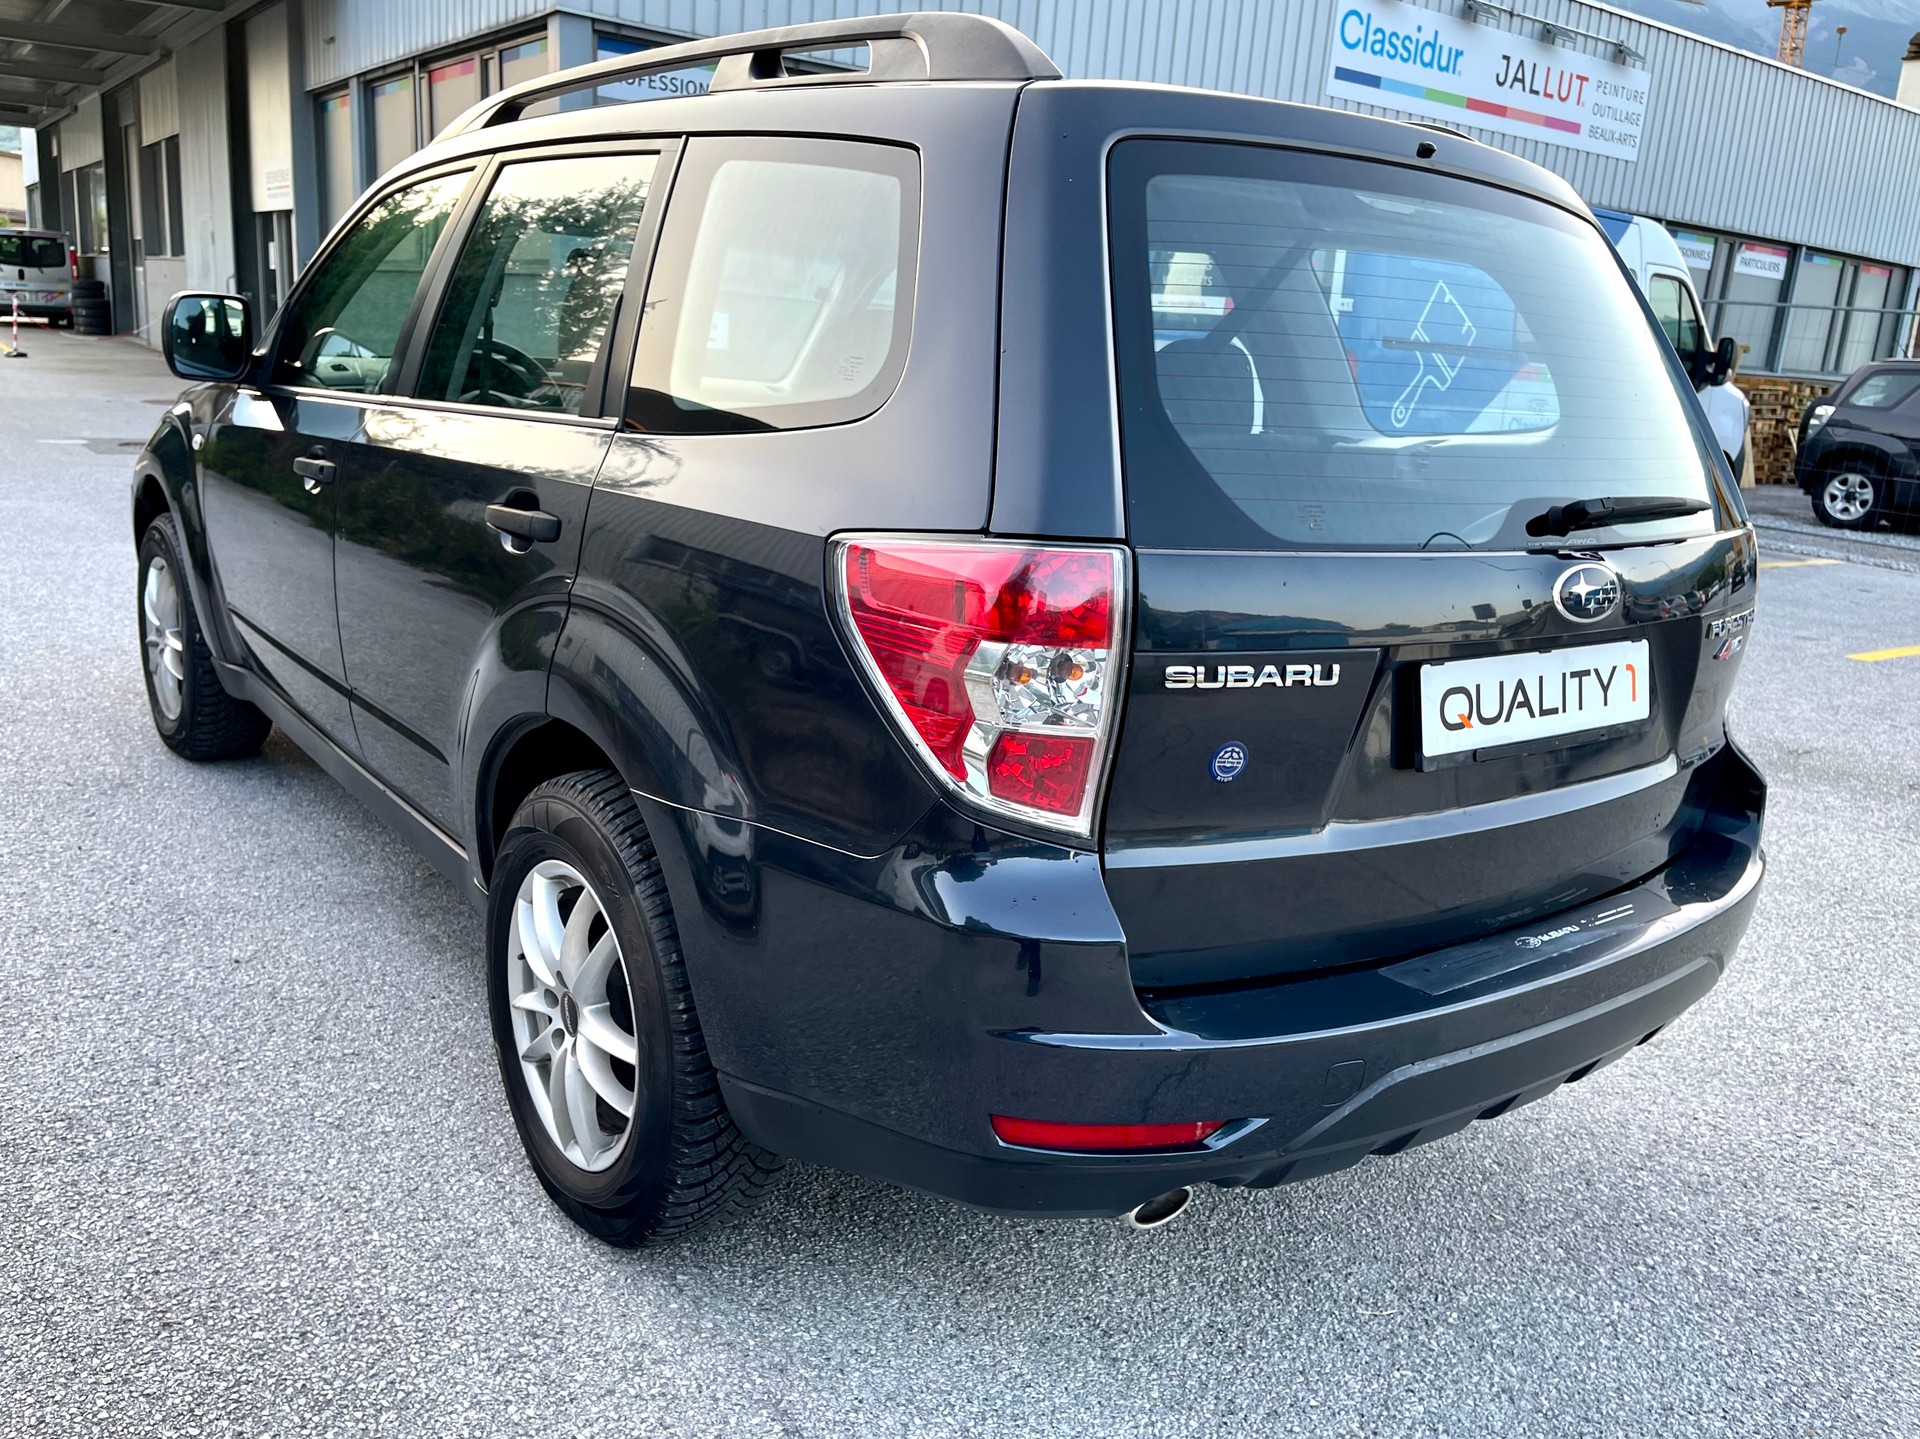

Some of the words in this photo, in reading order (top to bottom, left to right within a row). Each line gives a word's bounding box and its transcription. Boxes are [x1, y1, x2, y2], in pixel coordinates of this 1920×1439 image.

[1340, 9, 1464, 75] Classidur
[1495, 54, 1590, 106] JALLUT
[1596, 80, 1646, 105] PEINTURE
[1592, 103, 1642, 127] OUTILLAGE
[1587, 124, 1638, 149] BEAUX-ARTS
[1680, 246, 1711, 261] SONNELS
[1740, 256, 1781, 273] PARTICULIERS
[1164, 663, 1341, 689] SUBARU
